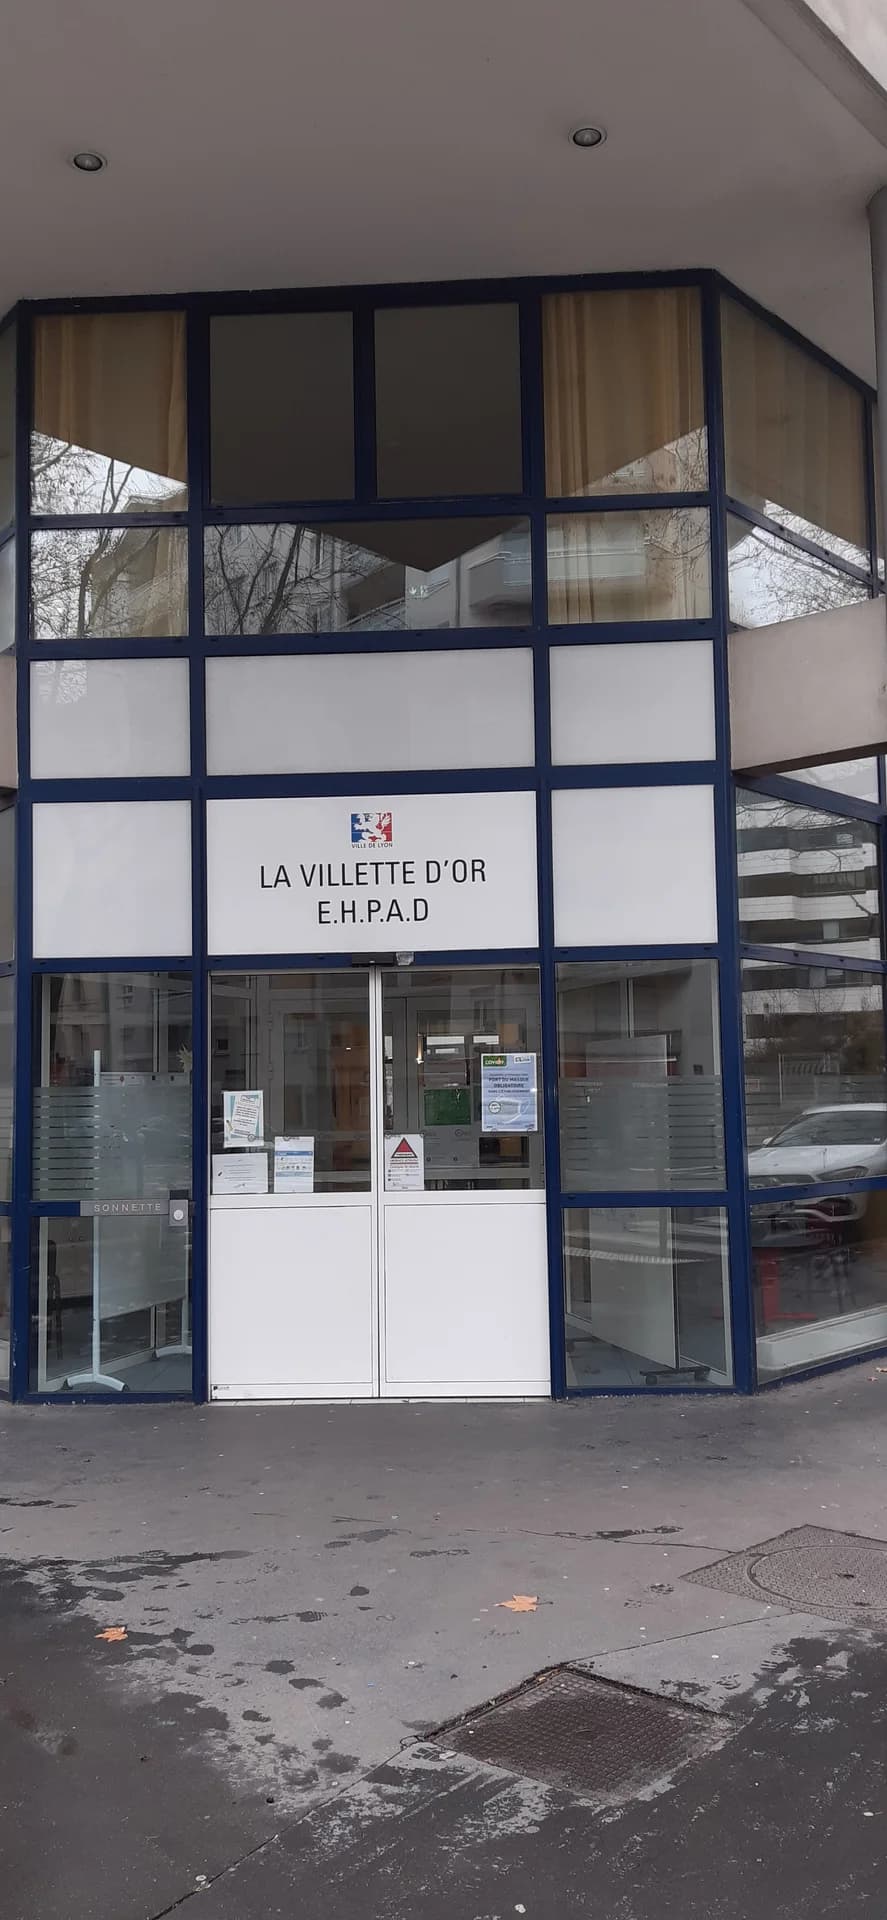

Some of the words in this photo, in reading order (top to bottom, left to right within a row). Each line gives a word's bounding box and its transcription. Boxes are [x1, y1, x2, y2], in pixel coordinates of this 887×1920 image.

[260, 864, 292, 889] LA
[300, 861, 416, 888] VILLETTE
[425, 858, 487, 884] D'OR
[317, 897, 429, 925] E.H.P.A.D
[94, 1203, 161, 1212] SONNETTE
